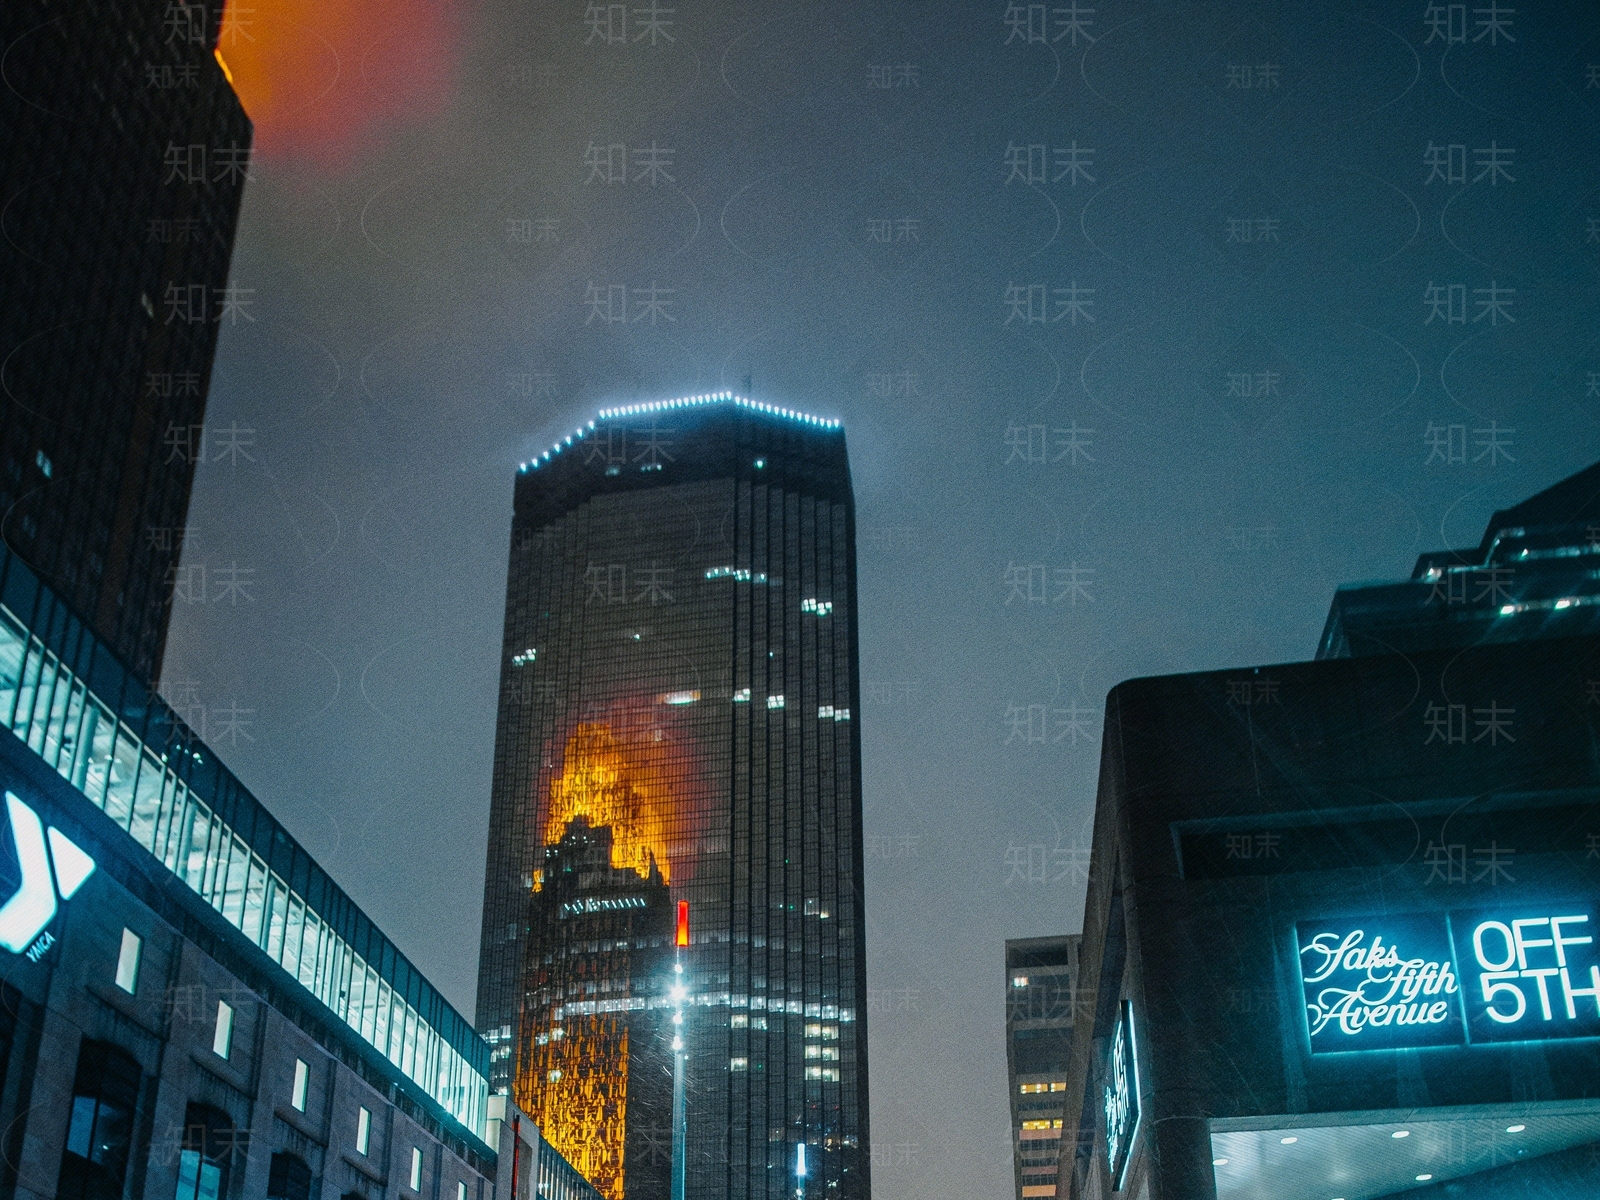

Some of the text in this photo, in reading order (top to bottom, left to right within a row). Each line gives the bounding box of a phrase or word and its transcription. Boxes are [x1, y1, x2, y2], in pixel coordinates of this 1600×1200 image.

[25, 930, 57, 963] YMCA
[1300, 929, 1399, 983] Saks
[1472, 914, 1593, 972] OFF
[1357, 958, 1458, 1005] Fifth
[1480, 965, 1600, 1023] 5TH
[1307, 987, 1448, 1035] Avenue
